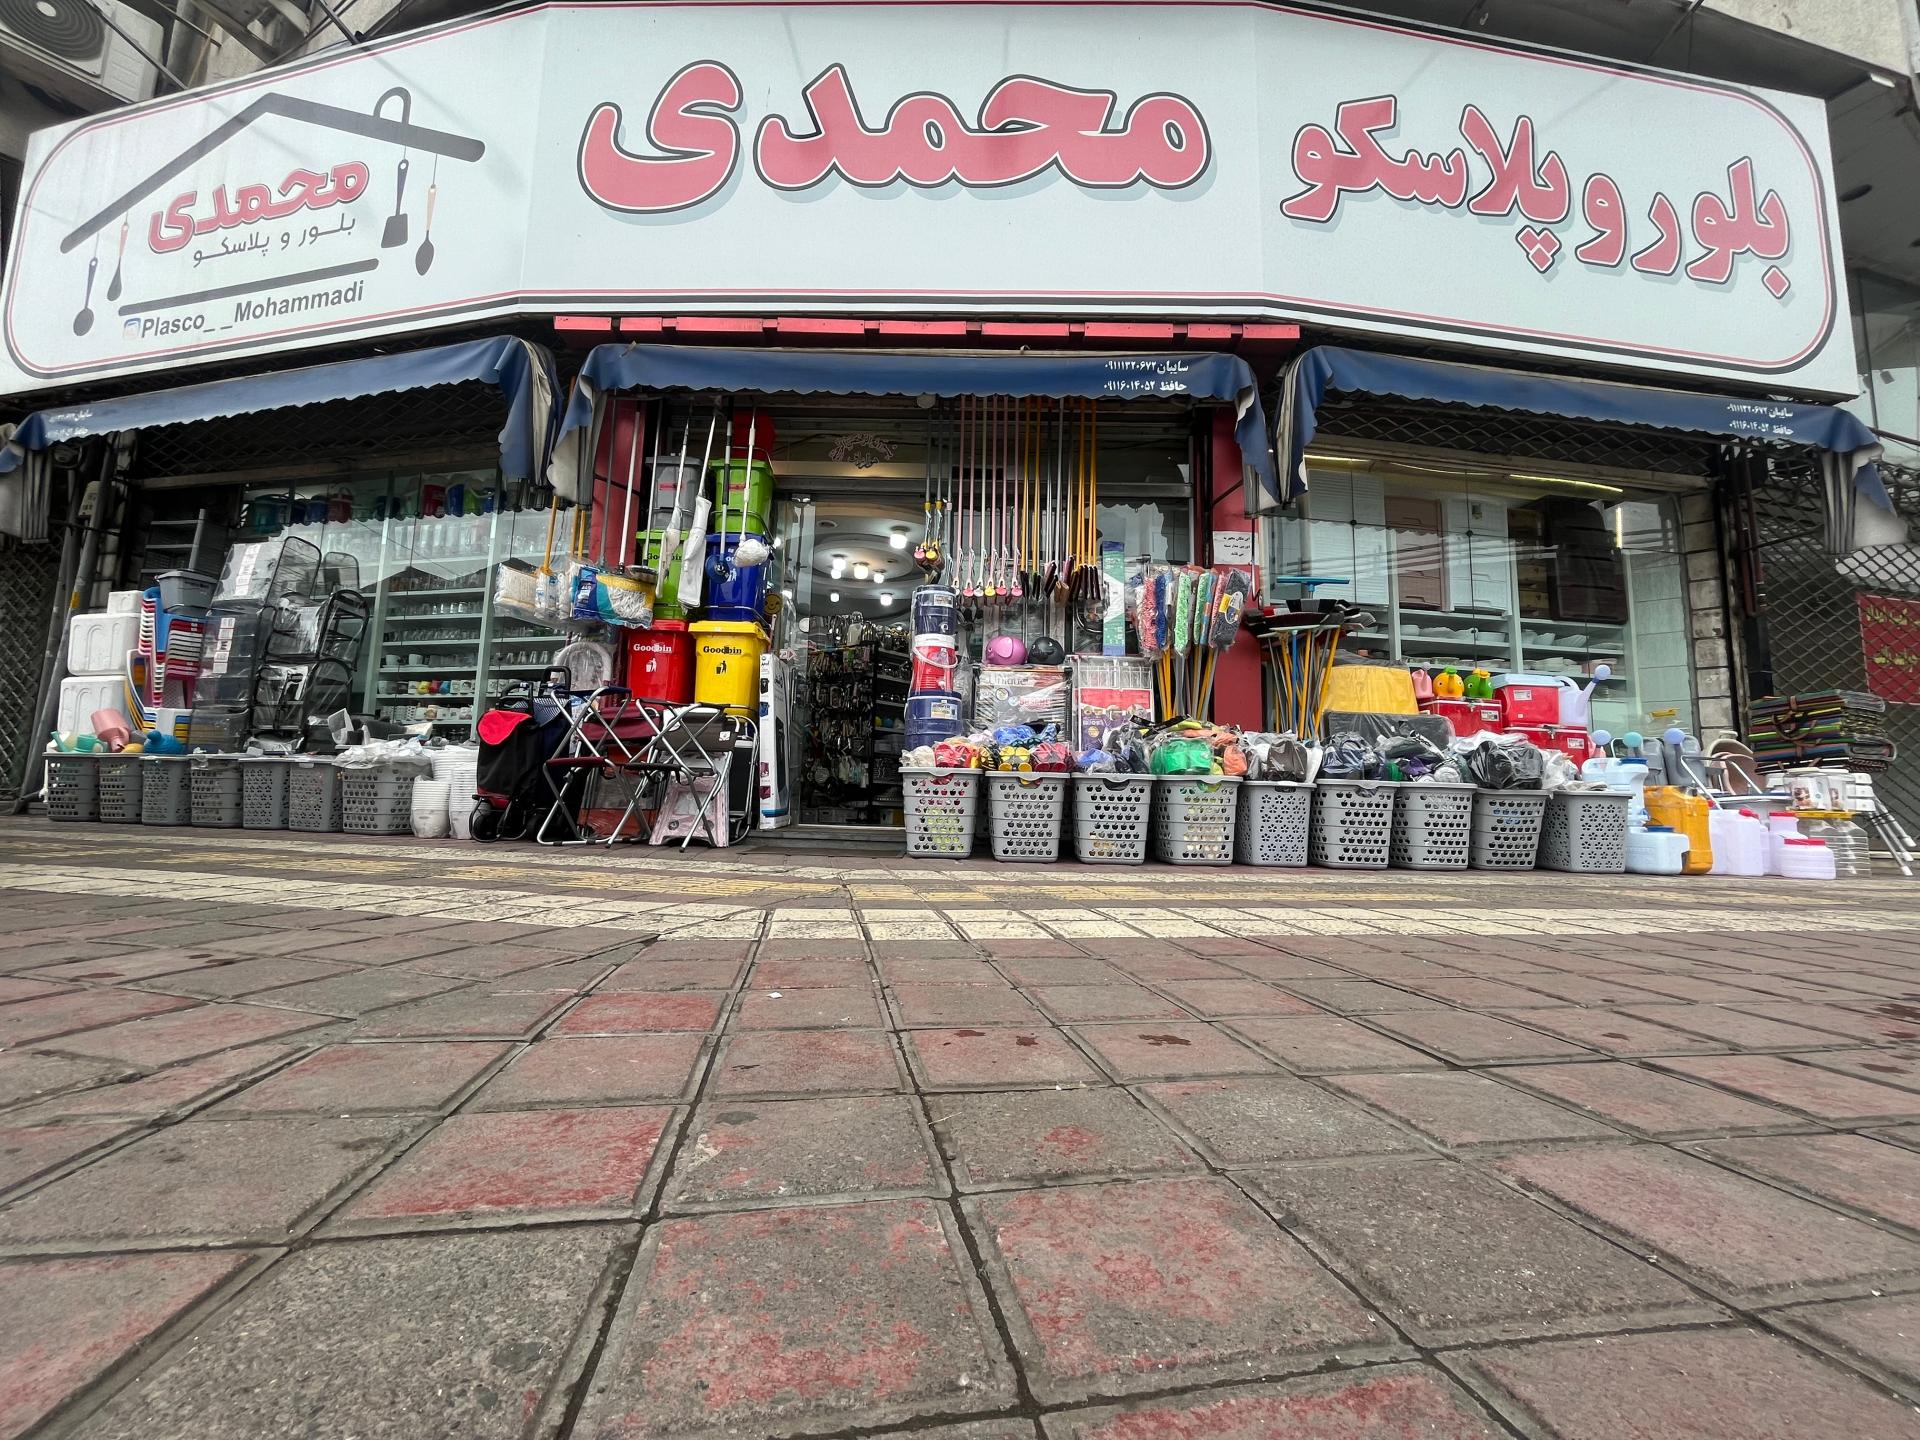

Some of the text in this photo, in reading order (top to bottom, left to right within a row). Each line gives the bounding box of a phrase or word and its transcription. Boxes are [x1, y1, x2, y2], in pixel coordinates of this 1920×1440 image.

[578, 60, 1212, 214] محمدی
[148, 160, 370, 254] محمدی
[1281, 95, 1790, 298] بلور و پلاسکو
[193, 213, 356, 268] بلور و پلاسکو
[1157, 360, 1189, 375] سایبان
[1160, 380, 1188, 391] حافظ
